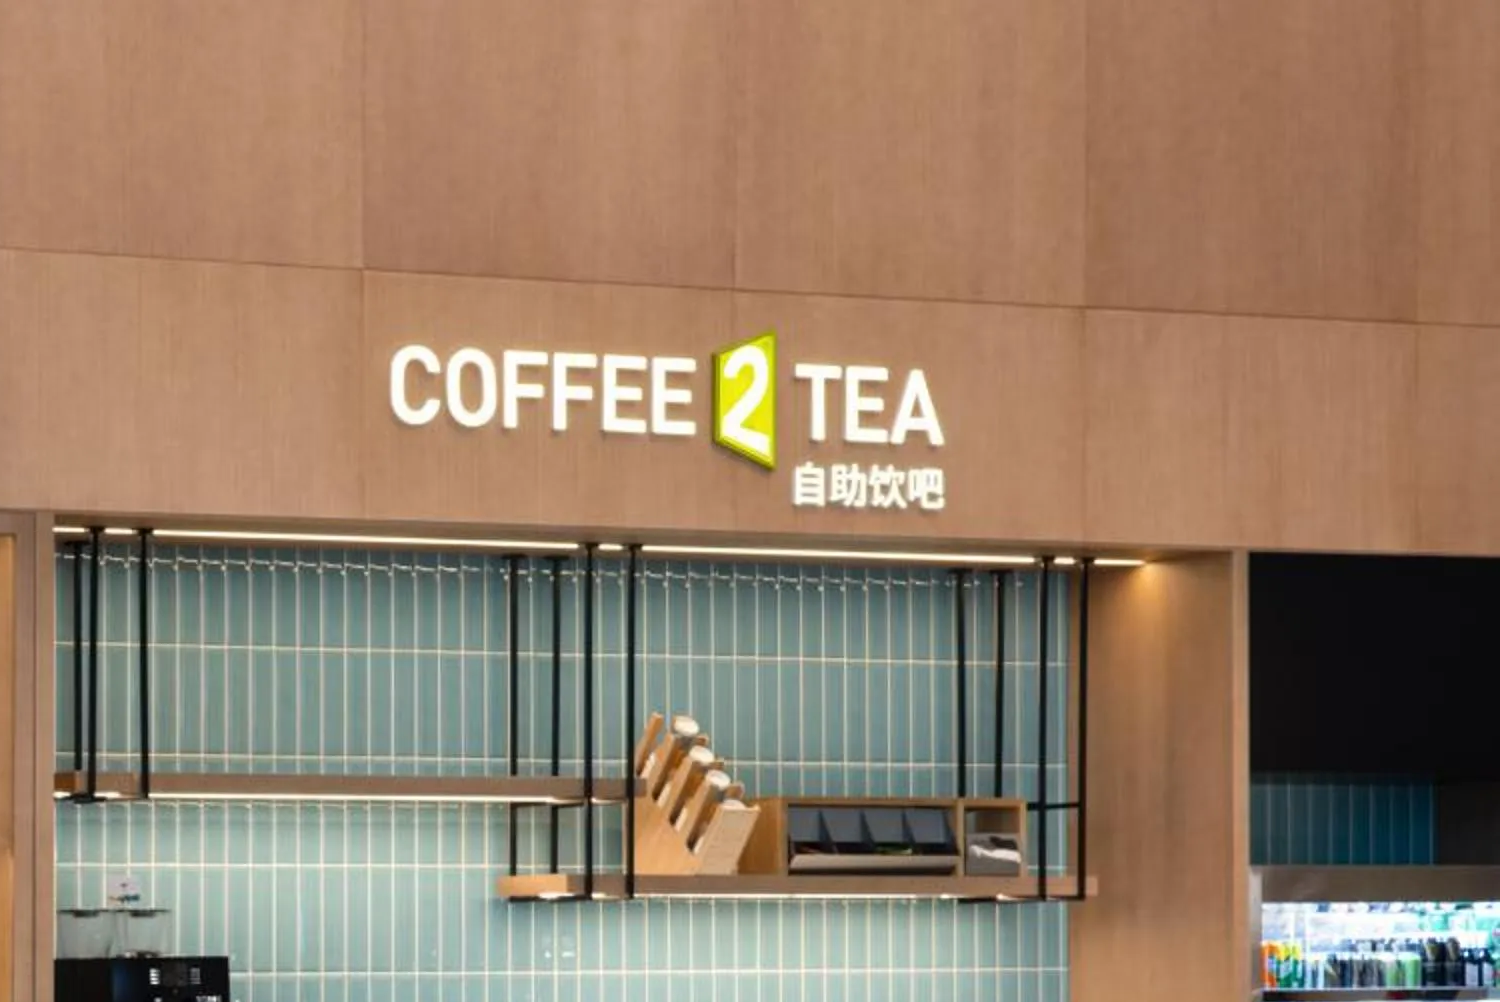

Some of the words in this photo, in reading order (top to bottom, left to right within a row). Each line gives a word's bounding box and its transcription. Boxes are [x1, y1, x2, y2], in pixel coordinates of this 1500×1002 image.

[389, 344, 696, 435] COFFEE
[722, 345, 770, 455] 2
[794, 363, 944, 446] TEA
[793, 461, 945, 509] 自助饮吧
